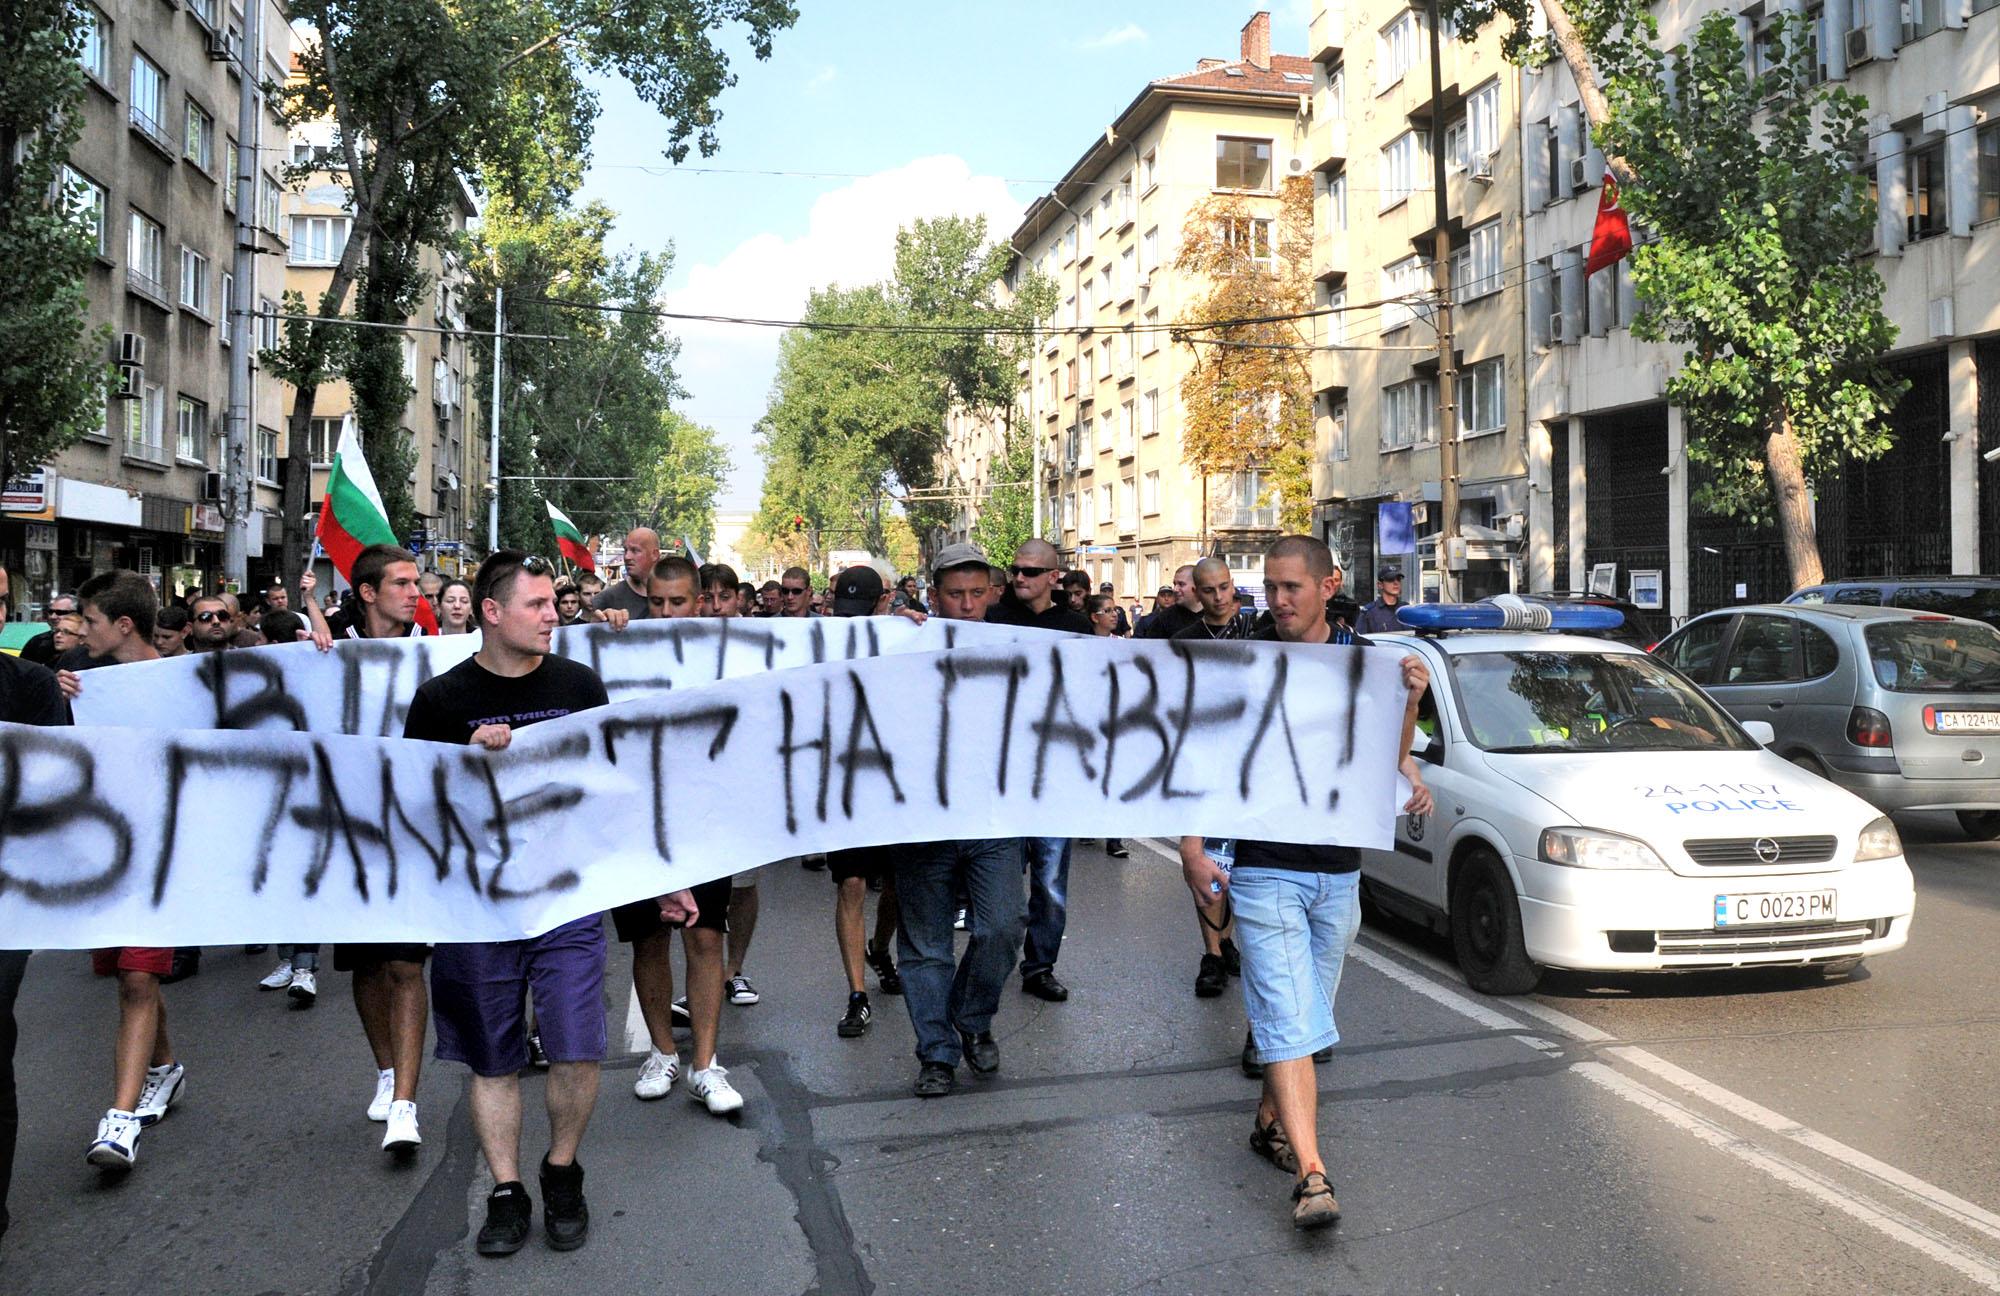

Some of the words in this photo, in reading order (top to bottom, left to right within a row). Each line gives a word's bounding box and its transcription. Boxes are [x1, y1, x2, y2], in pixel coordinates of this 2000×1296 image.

[467, 716, 511, 728] TOM
[777, 667, 906, 835] НА
[935, 640, 1365, 811] ПАВЕЛ!
[1665, 799, 1805, 814] POLICE
